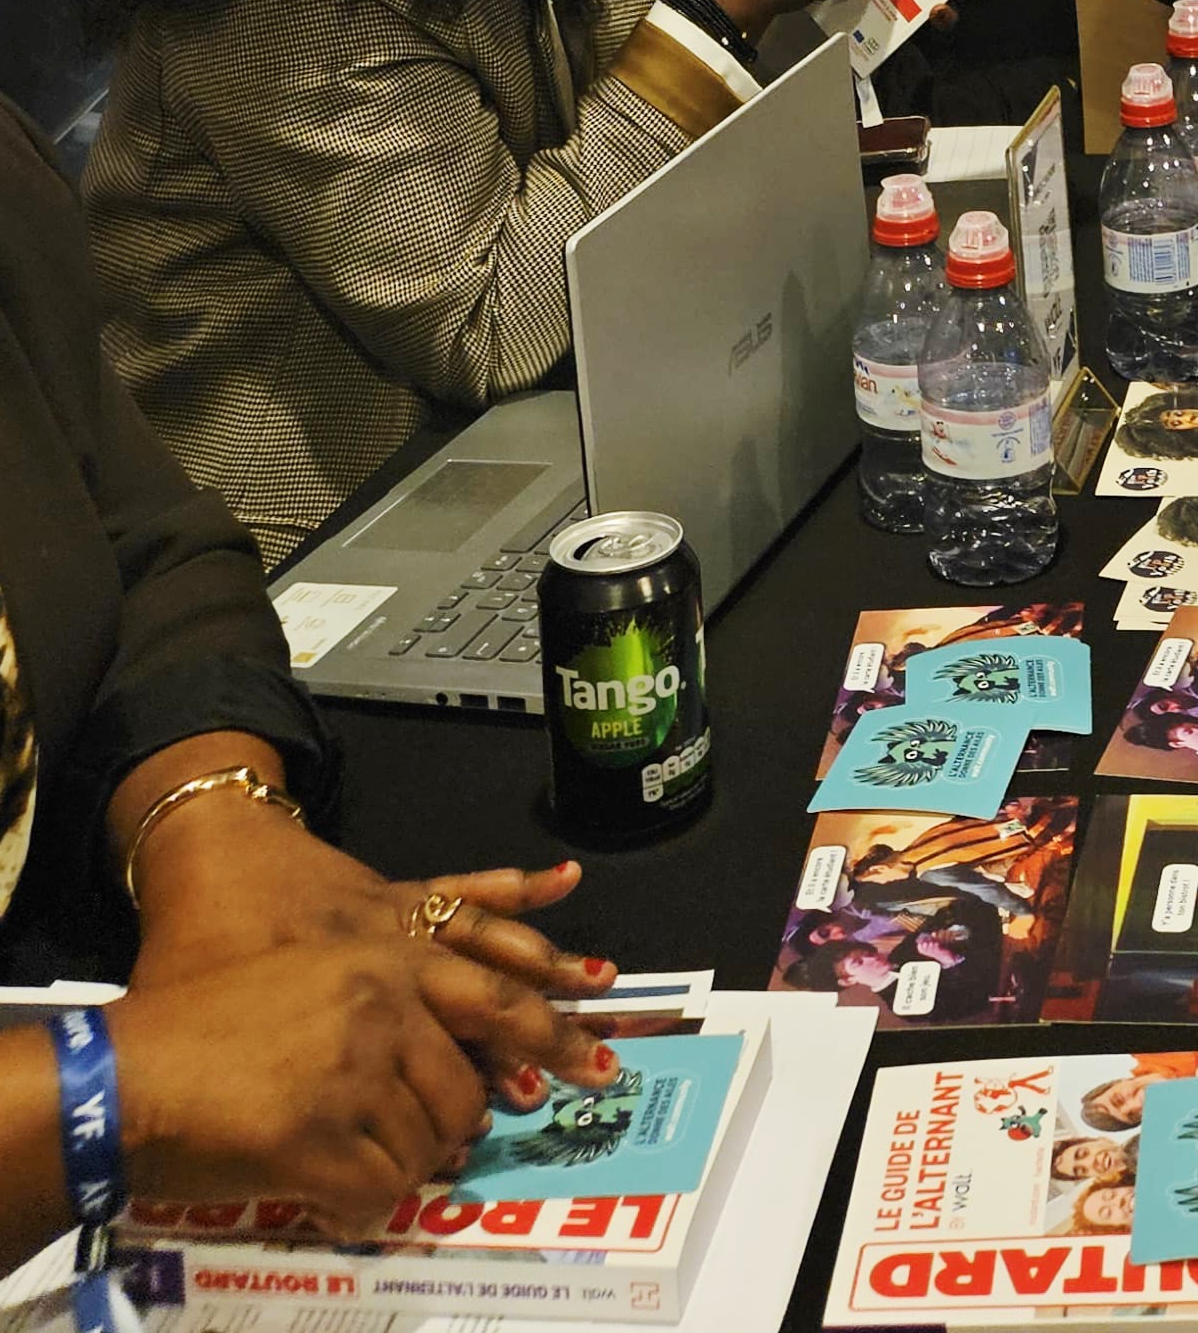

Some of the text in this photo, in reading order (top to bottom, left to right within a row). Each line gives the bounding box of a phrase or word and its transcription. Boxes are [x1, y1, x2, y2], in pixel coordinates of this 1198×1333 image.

[1025, 660, 1037, 698] L'ALTERNANCE
[1035, 659, 1046, 698] DONNE DES AILES
[591, 717, 643, 739] APPLE
[972, 732, 985, 747] AILES
[948, 732, 975, 777] L'ALTERNANCE
[967, 748, 978, 758] DES
[958, 759, 972, 778] DONNE
[1165, 885, 1176, 914] personne
[910, 1072, 964, 1230] L'ALTERNANT
[874, 1110, 920, 1231] LE GUIDE DE
[558, 1194, 666, 1238] LE
[194, 1270, 355, 1295] LE ROUTARD
[373, 1278, 570, 1299] LE GUIDE DE L'ALTERNANT
